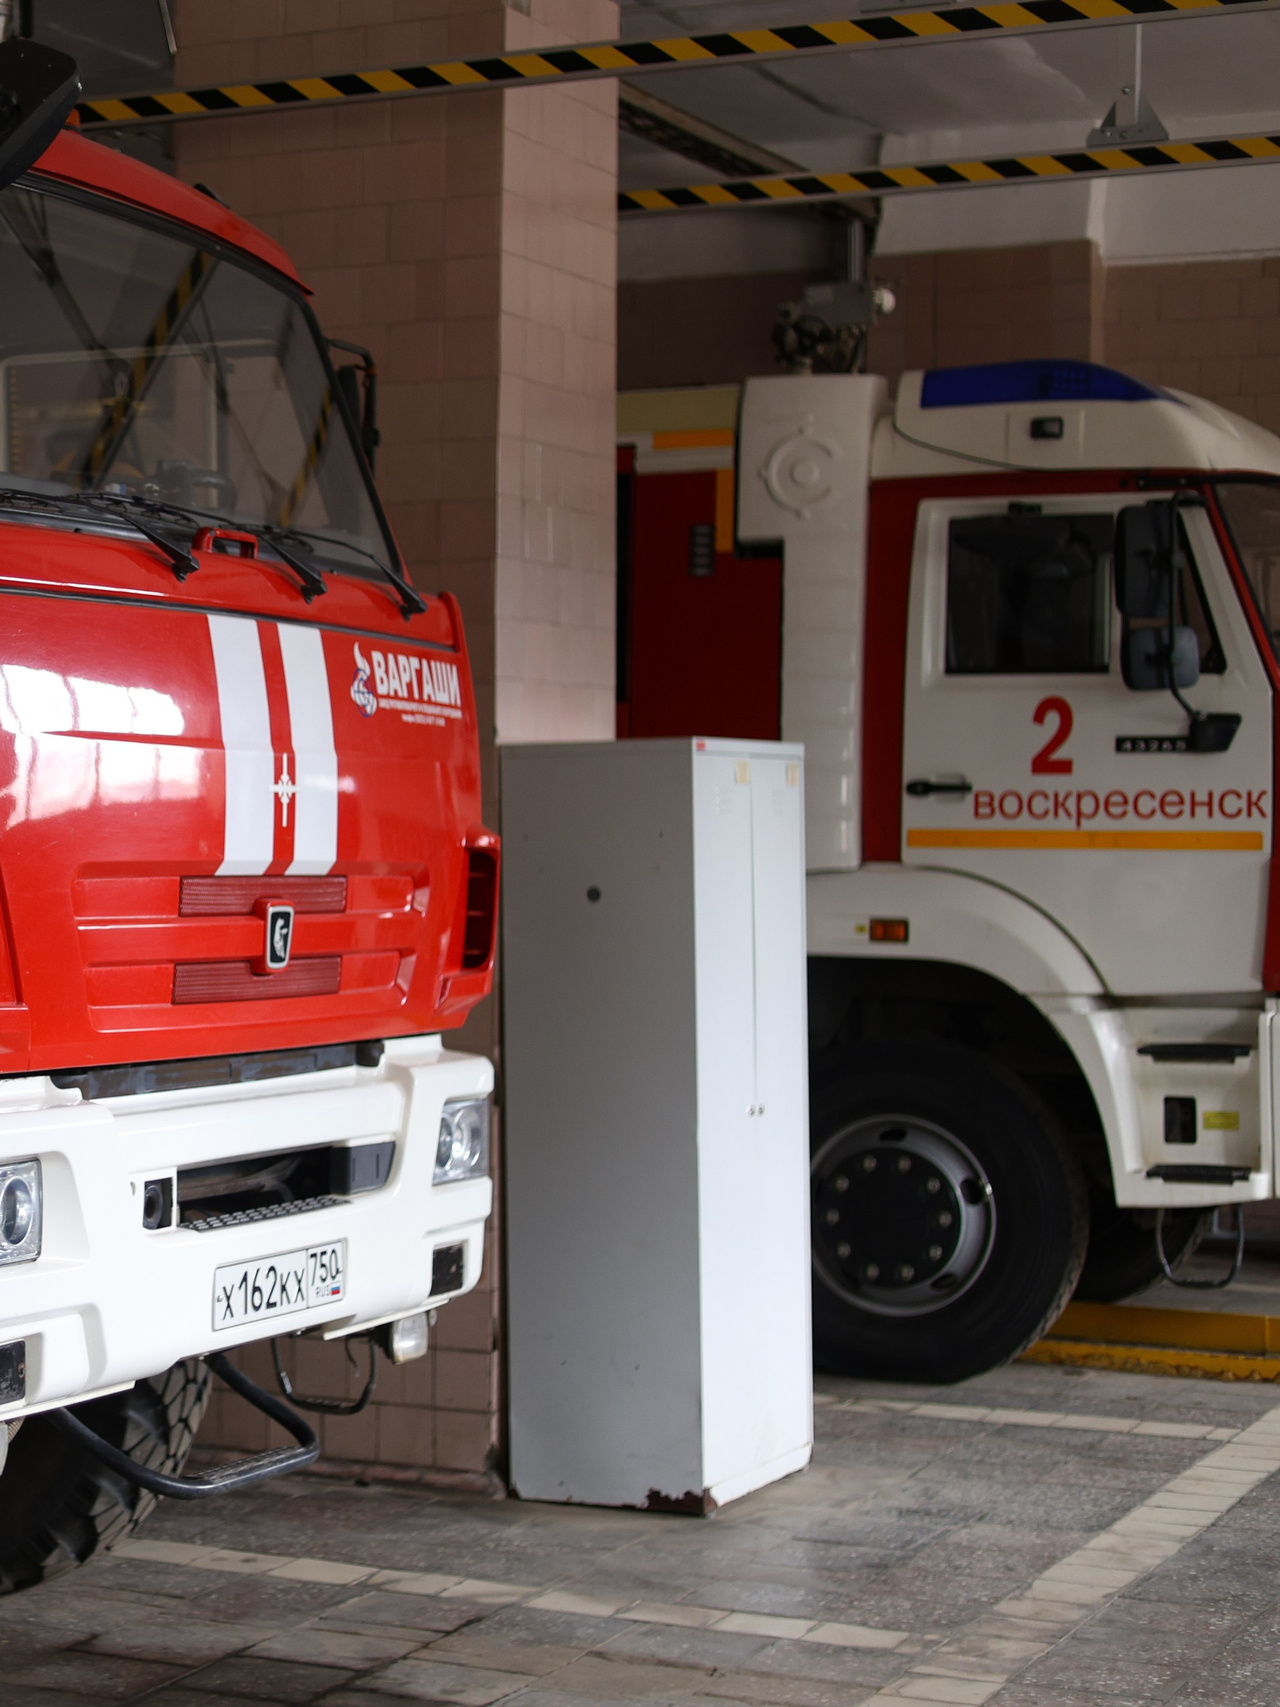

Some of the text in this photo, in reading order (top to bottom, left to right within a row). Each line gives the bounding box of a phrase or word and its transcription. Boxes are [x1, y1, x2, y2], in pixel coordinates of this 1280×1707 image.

[371, 650, 461, 707] ВАРГАШИ
[1031, 695, 1074, 776] 2
[973, 790, 1267, 830] воскресенск
